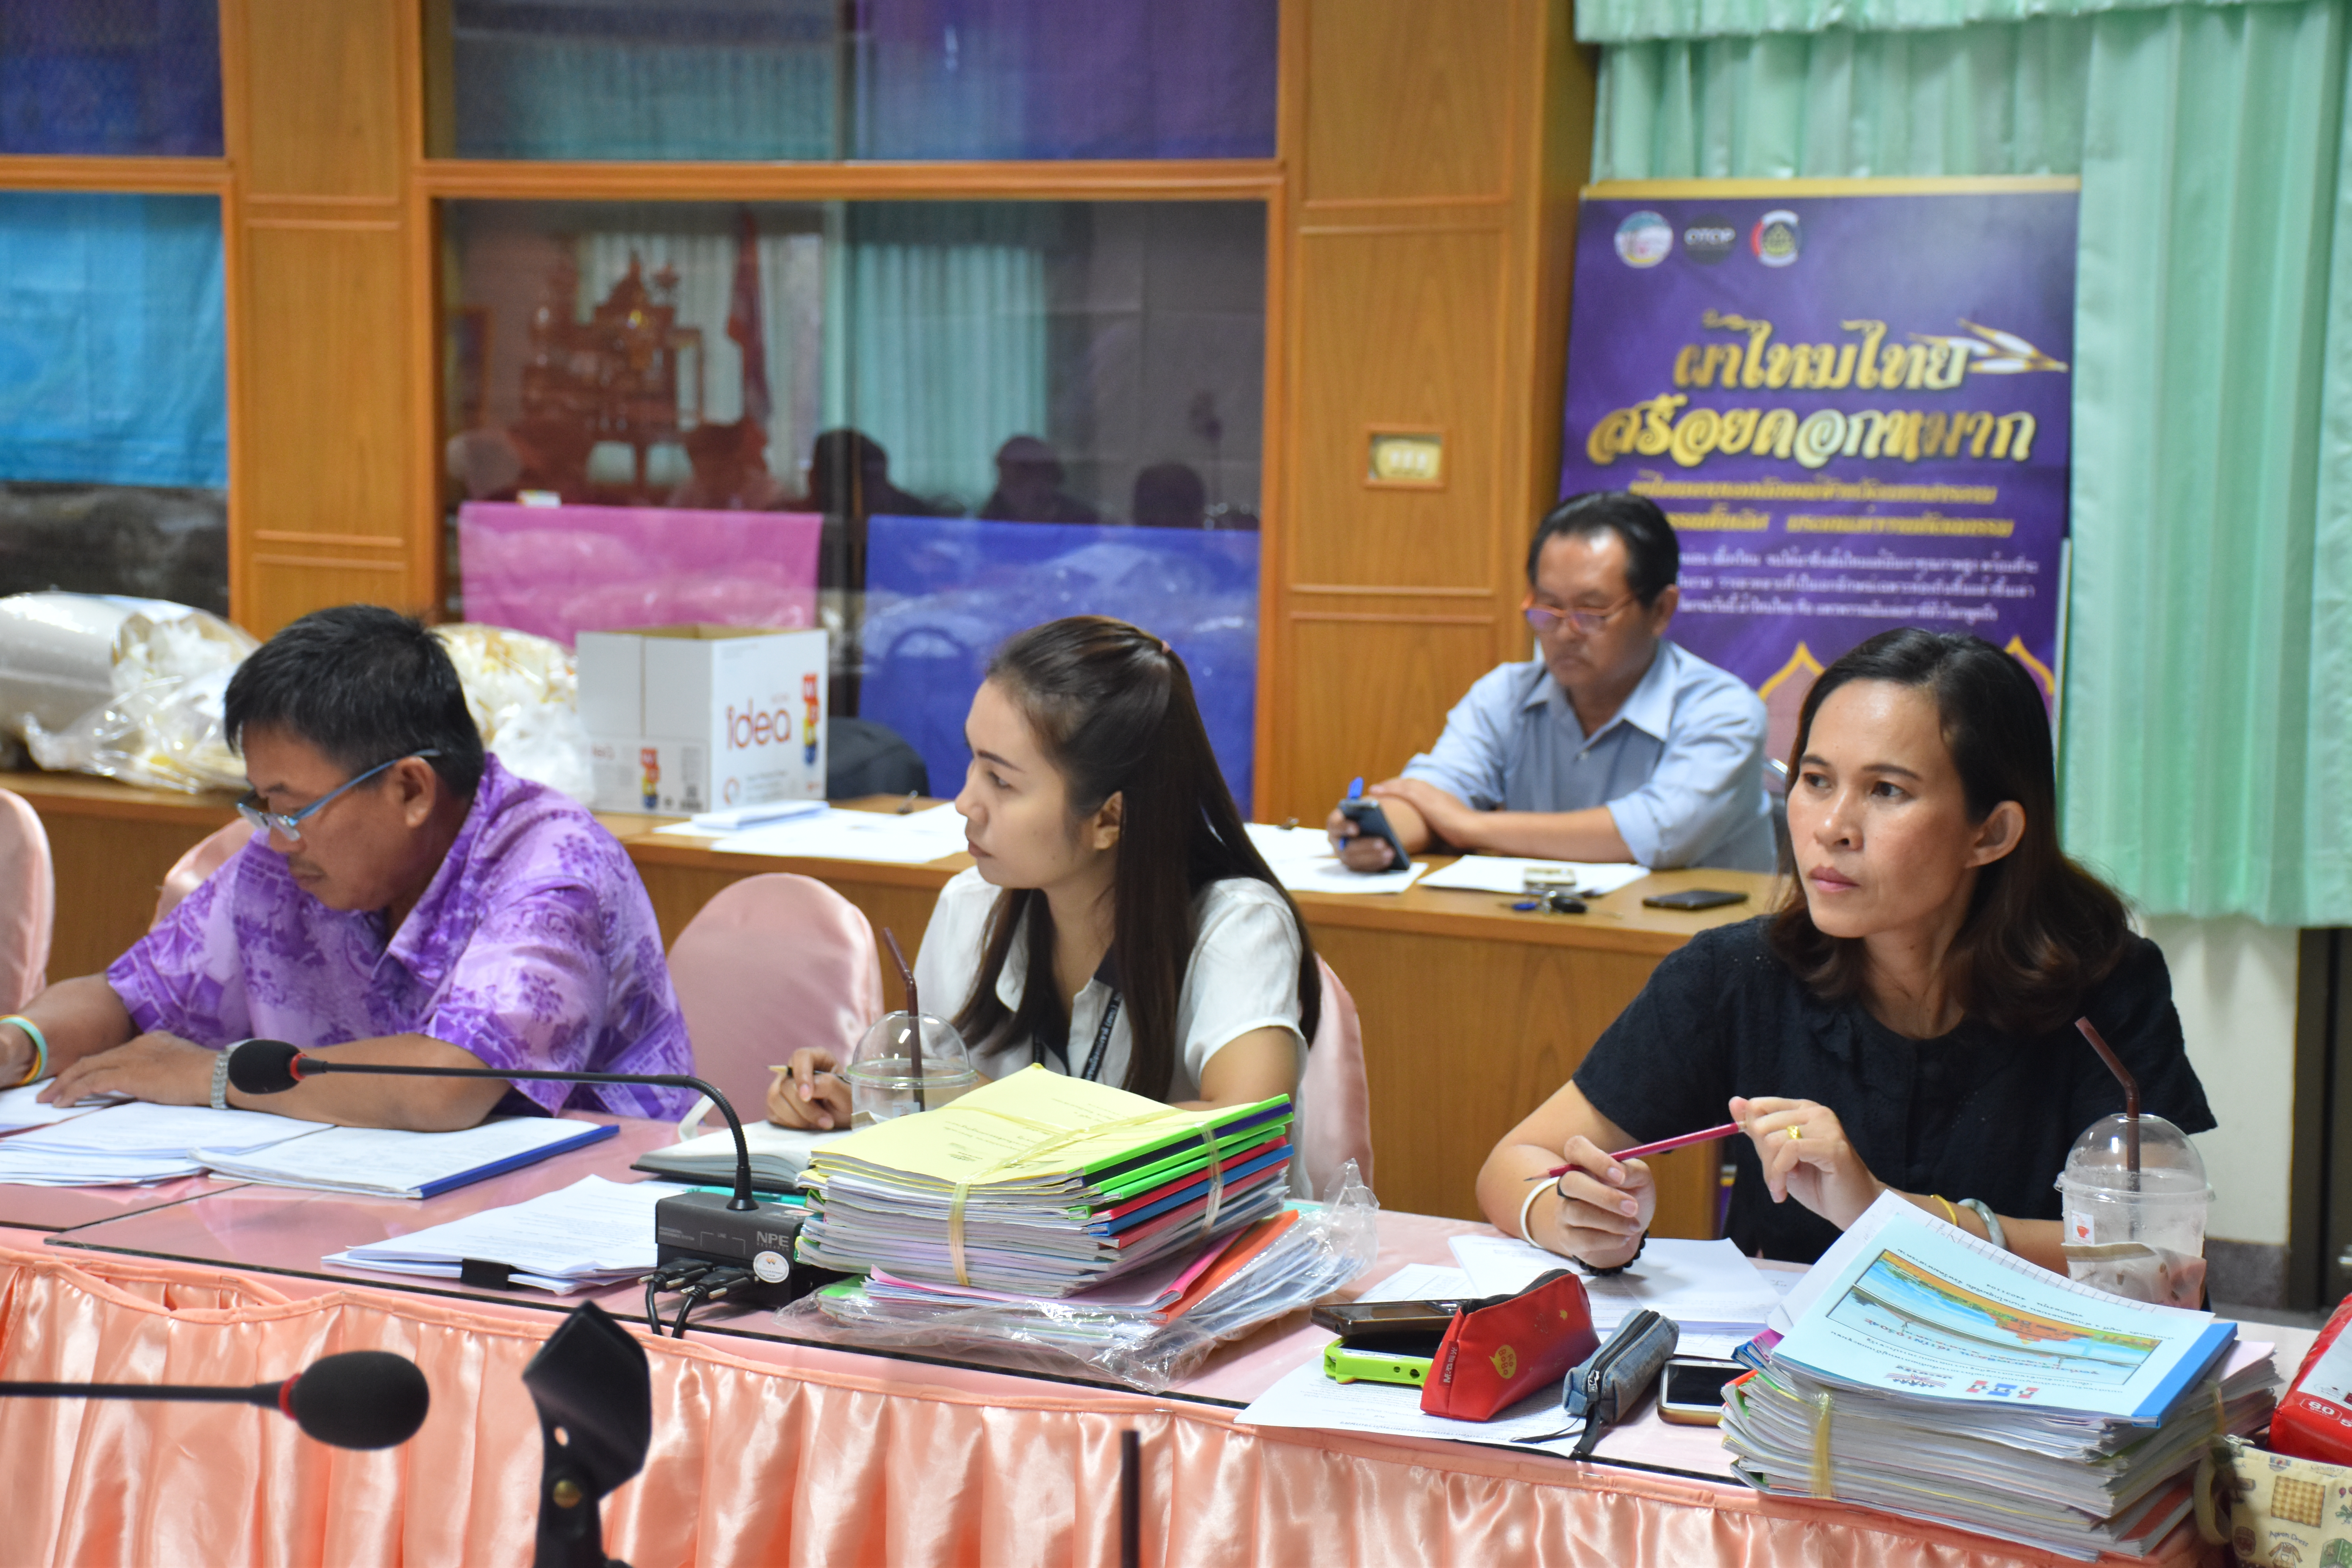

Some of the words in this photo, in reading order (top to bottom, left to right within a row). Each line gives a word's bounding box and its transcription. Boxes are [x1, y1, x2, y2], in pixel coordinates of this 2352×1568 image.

[726, 696, 792, 750] idea
[757, 1231, 789, 1247] NPE
[1985, 1283, 2026, 1301] 44031104
[2308, 1401, 2335, 1415] 80
[2269, 1530, 2289, 1540] Apron
[2291, 1534, 2309, 1547] Dress
